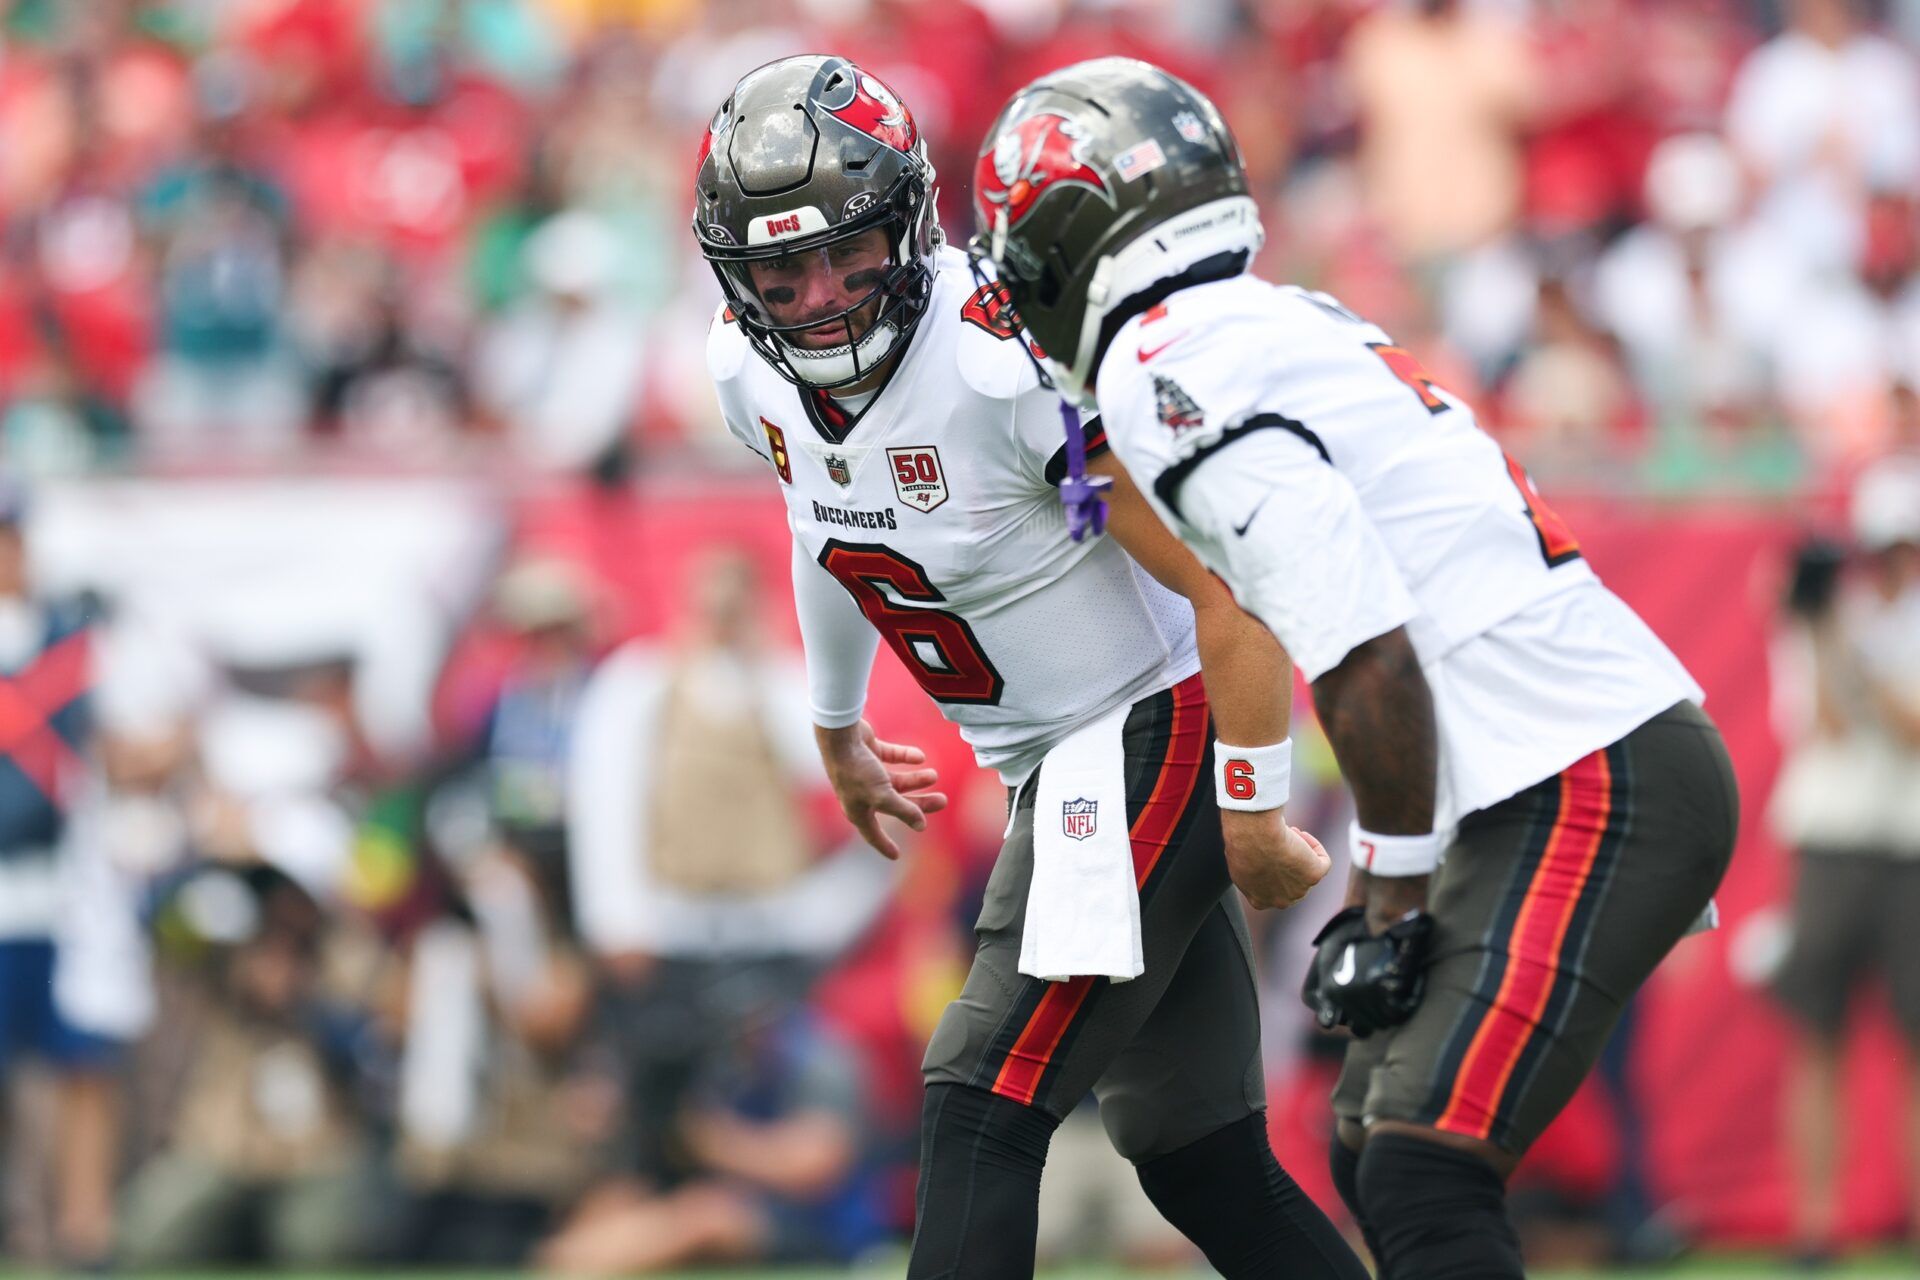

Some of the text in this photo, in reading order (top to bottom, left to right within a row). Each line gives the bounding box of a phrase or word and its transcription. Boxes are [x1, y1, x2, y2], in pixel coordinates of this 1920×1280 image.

[844, 199, 878, 220] OAKLEY
[893, 453, 939, 484] 50
[812, 500, 897, 531] BUCCANEERS
[817, 537, 1005, 706] 6
[1224, 759, 1256, 800] 6
[1066, 815, 1094, 836] NFL
[1359, 840, 1376, 869] 7
